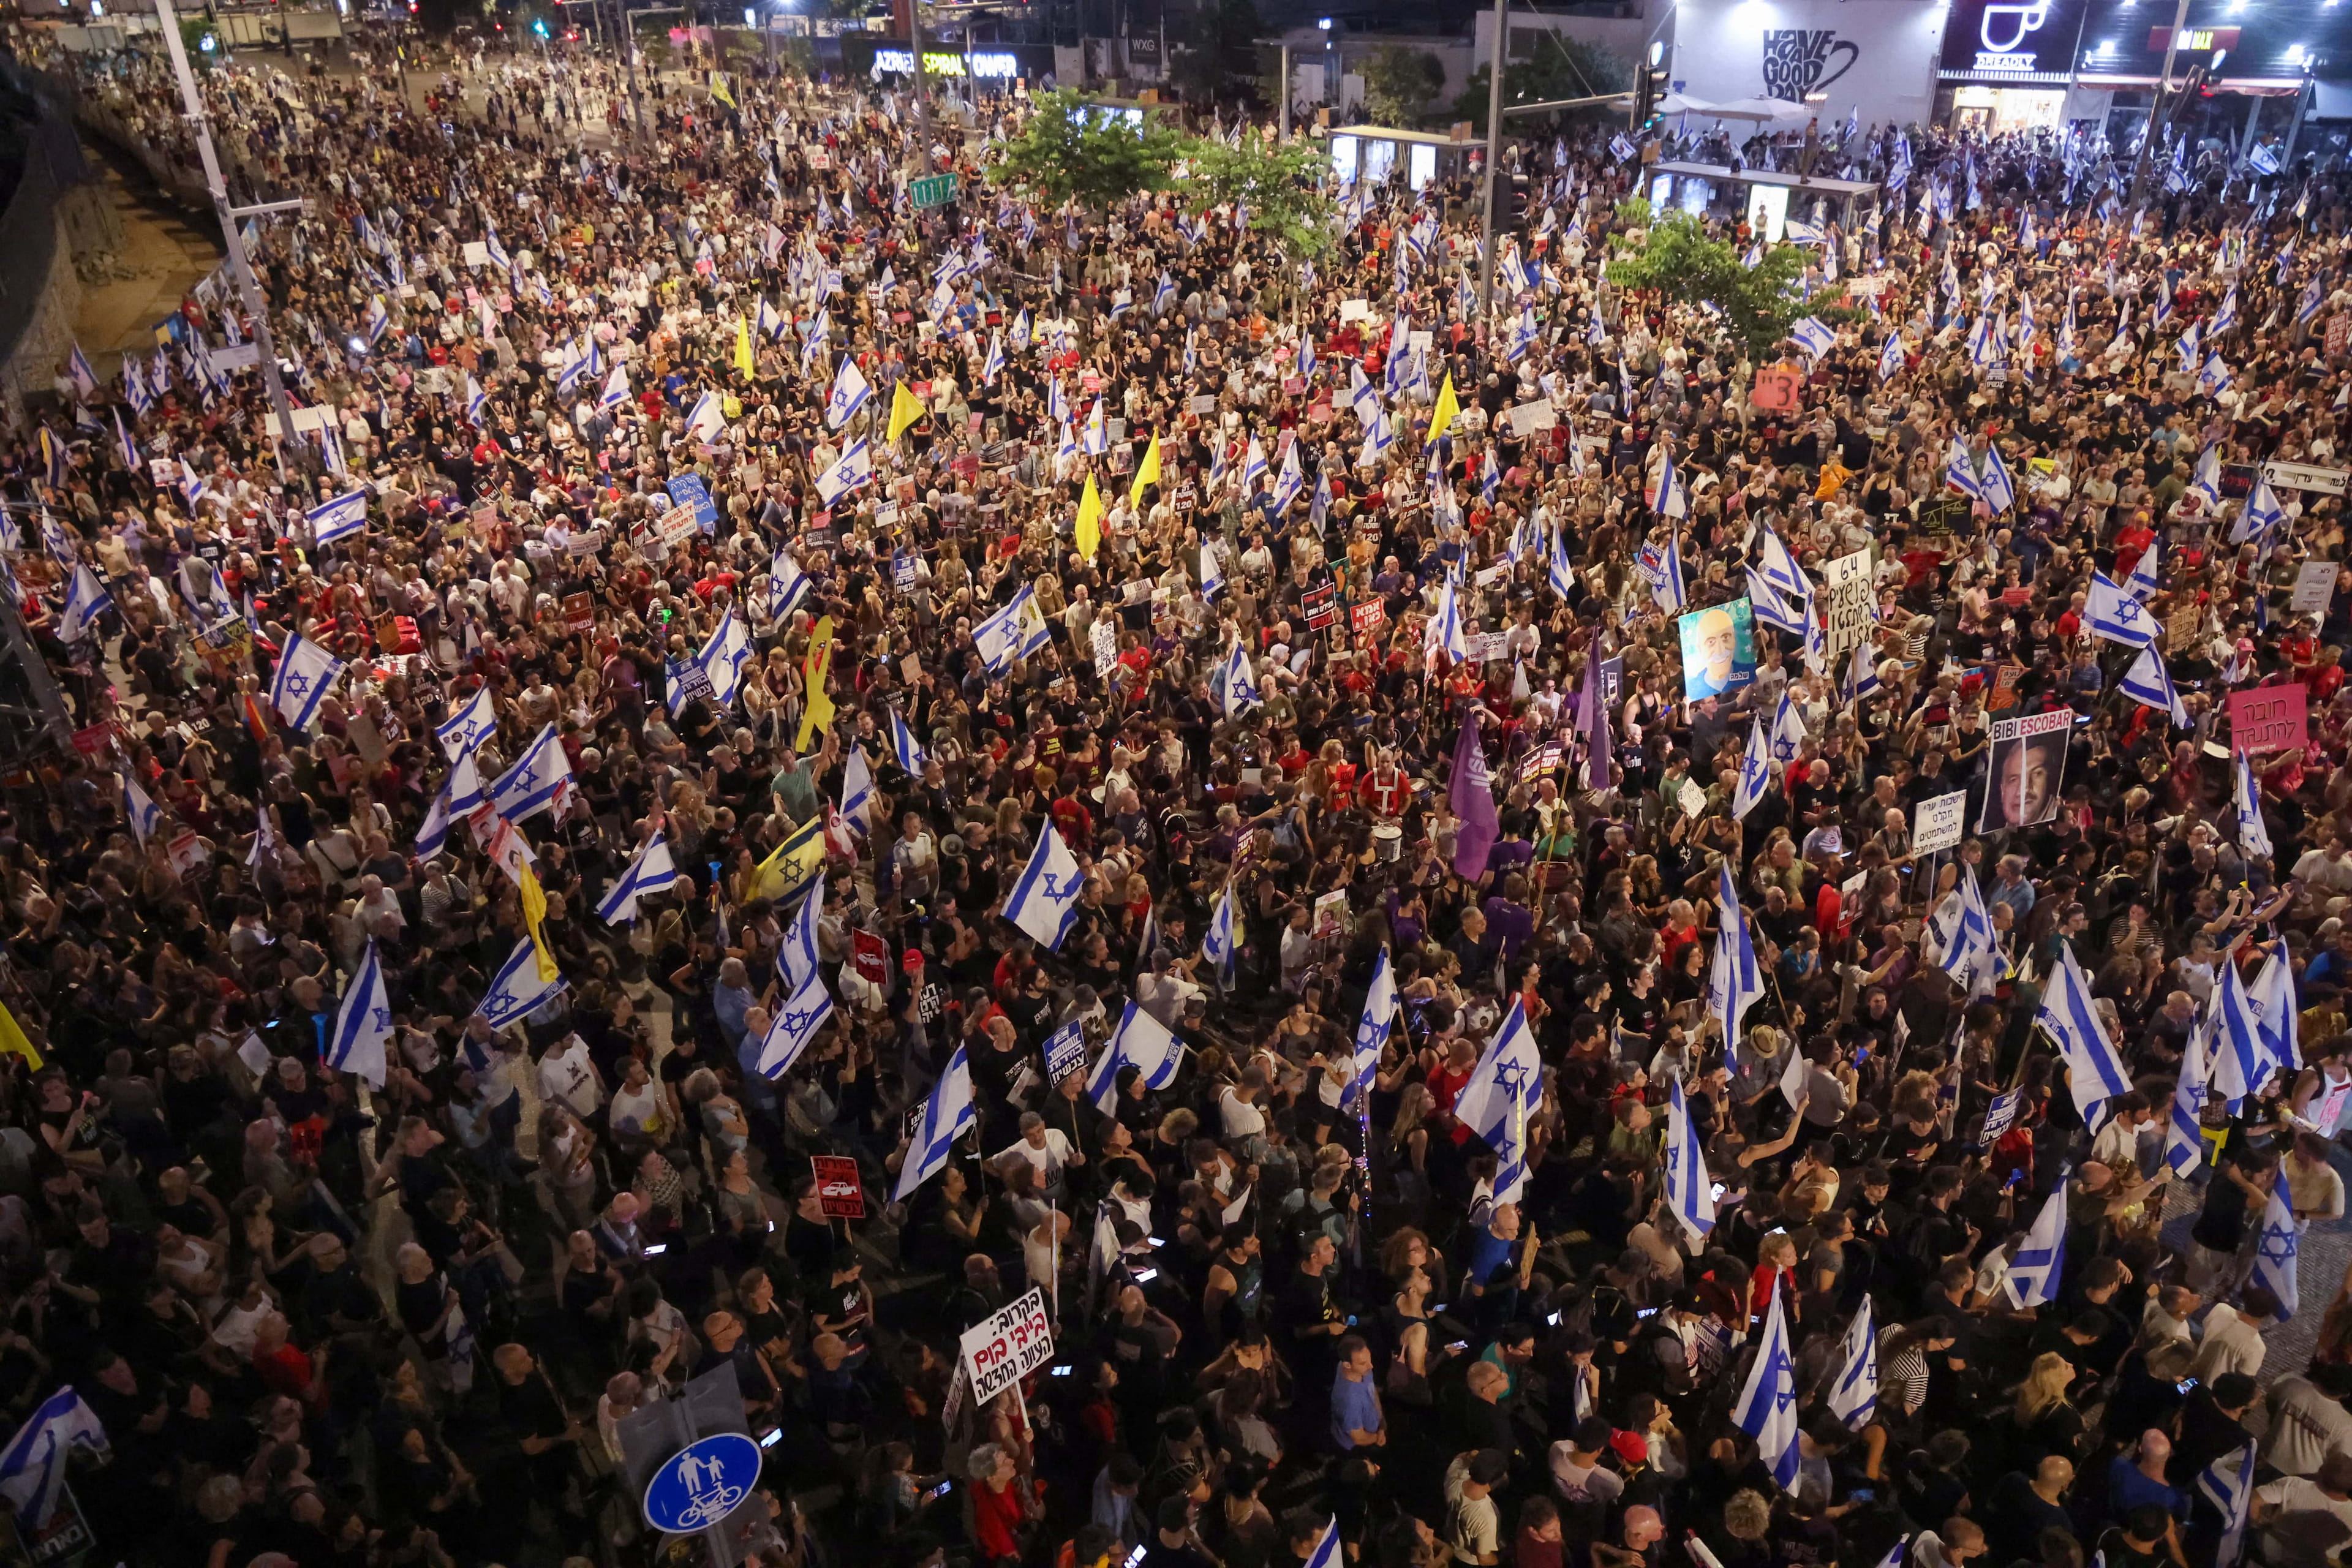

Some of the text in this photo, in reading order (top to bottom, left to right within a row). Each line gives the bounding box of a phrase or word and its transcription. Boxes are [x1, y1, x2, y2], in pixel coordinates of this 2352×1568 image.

[1133, 39, 1155, 51] WXG
[922, 53, 967, 75] SPIRAL
[1763, 57, 1824, 86] GOOD
[1977, 55, 2035, 69] BREADLY
[1176, 500, 1192, 511] 120
[1841, 556, 1858, 581] 64
[1829, 578, 1869, 610] פושעים
[1355, 601, 1380, 618] אמא
[1364, 611, 1381, 627] כאן
[1730, 672, 1749, 680] שלמה
[2243, 699, 2286, 722] חובה
[191, 718, 210, 731] 120
[1993, 711, 2070, 739] BIBI ESCOBAR
[2235, 722, 2296, 746] להתנגד
[1924, 801, 1936, 812] ערי
[1932, 809, 1953, 823] מקלט
[1920, 821, 1957, 842] למשתמטים
[1049, 1043, 1084, 1072] בחירות
[973, 1313, 1046, 1374] בייבי בום
[1021, 1337, 1051, 1373] העונה
[976, 1357, 1018, 1397] החדשה
